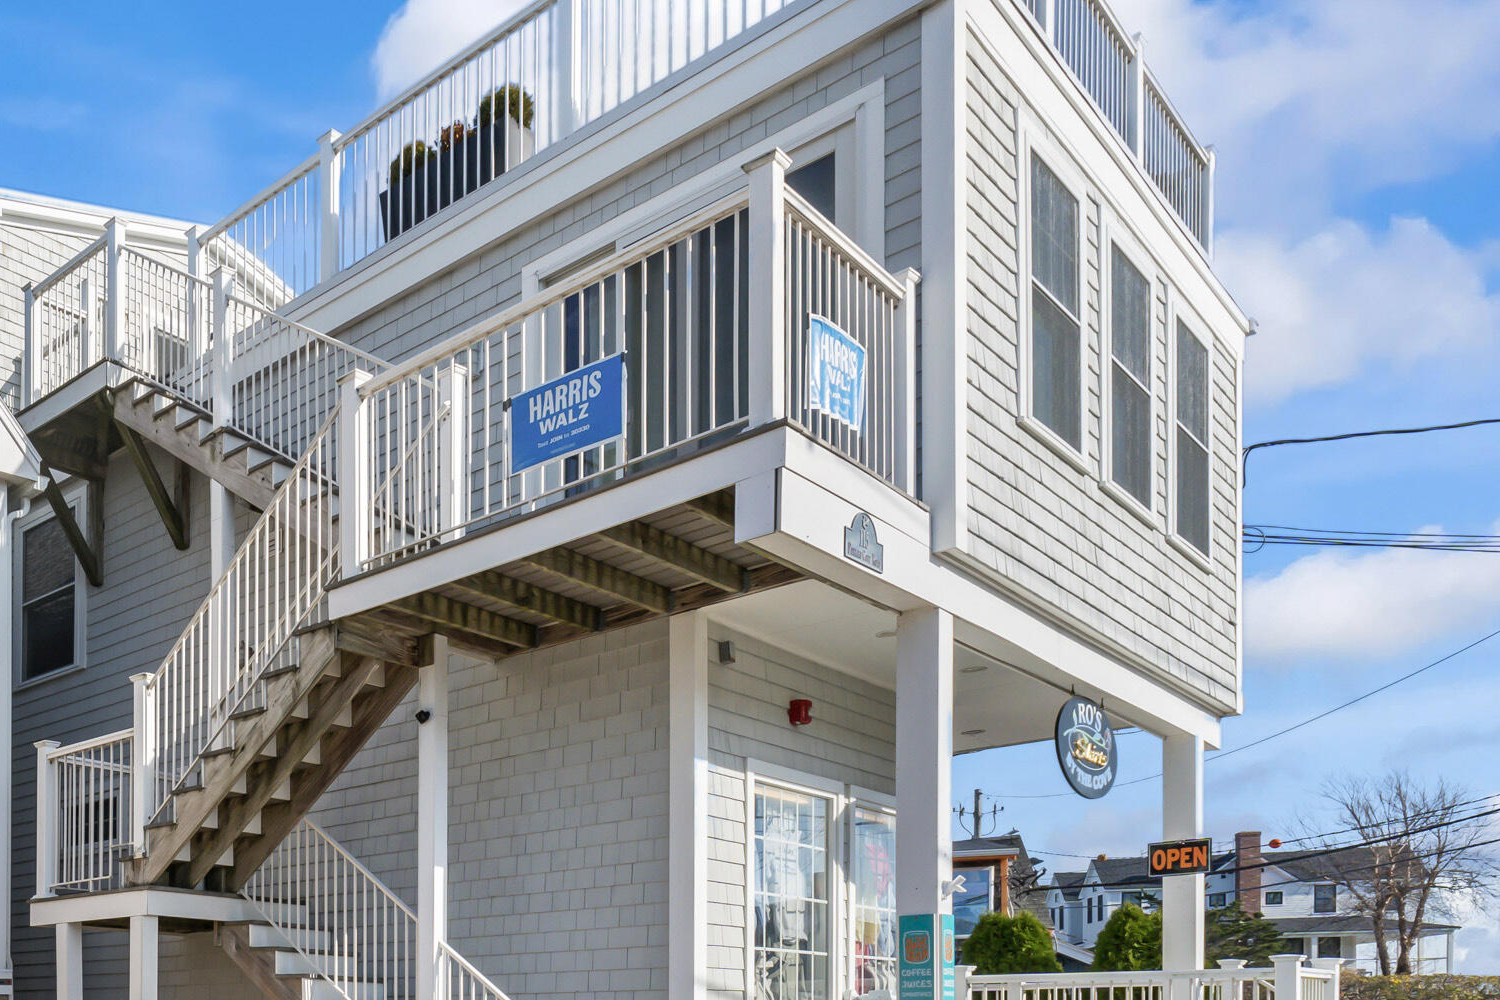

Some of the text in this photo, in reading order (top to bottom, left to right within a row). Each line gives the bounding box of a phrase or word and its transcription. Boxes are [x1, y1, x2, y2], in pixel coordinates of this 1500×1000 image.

[528, 370, 602, 424] HARRIS
[538, 402, 589, 435] WALZ
[1077, 703, 1103, 732] RO'S
[1151, 845, 1208, 871] OPEN
[901, 968, 932, 976] COFFEE
[901, 980, 933, 989] JUICES
